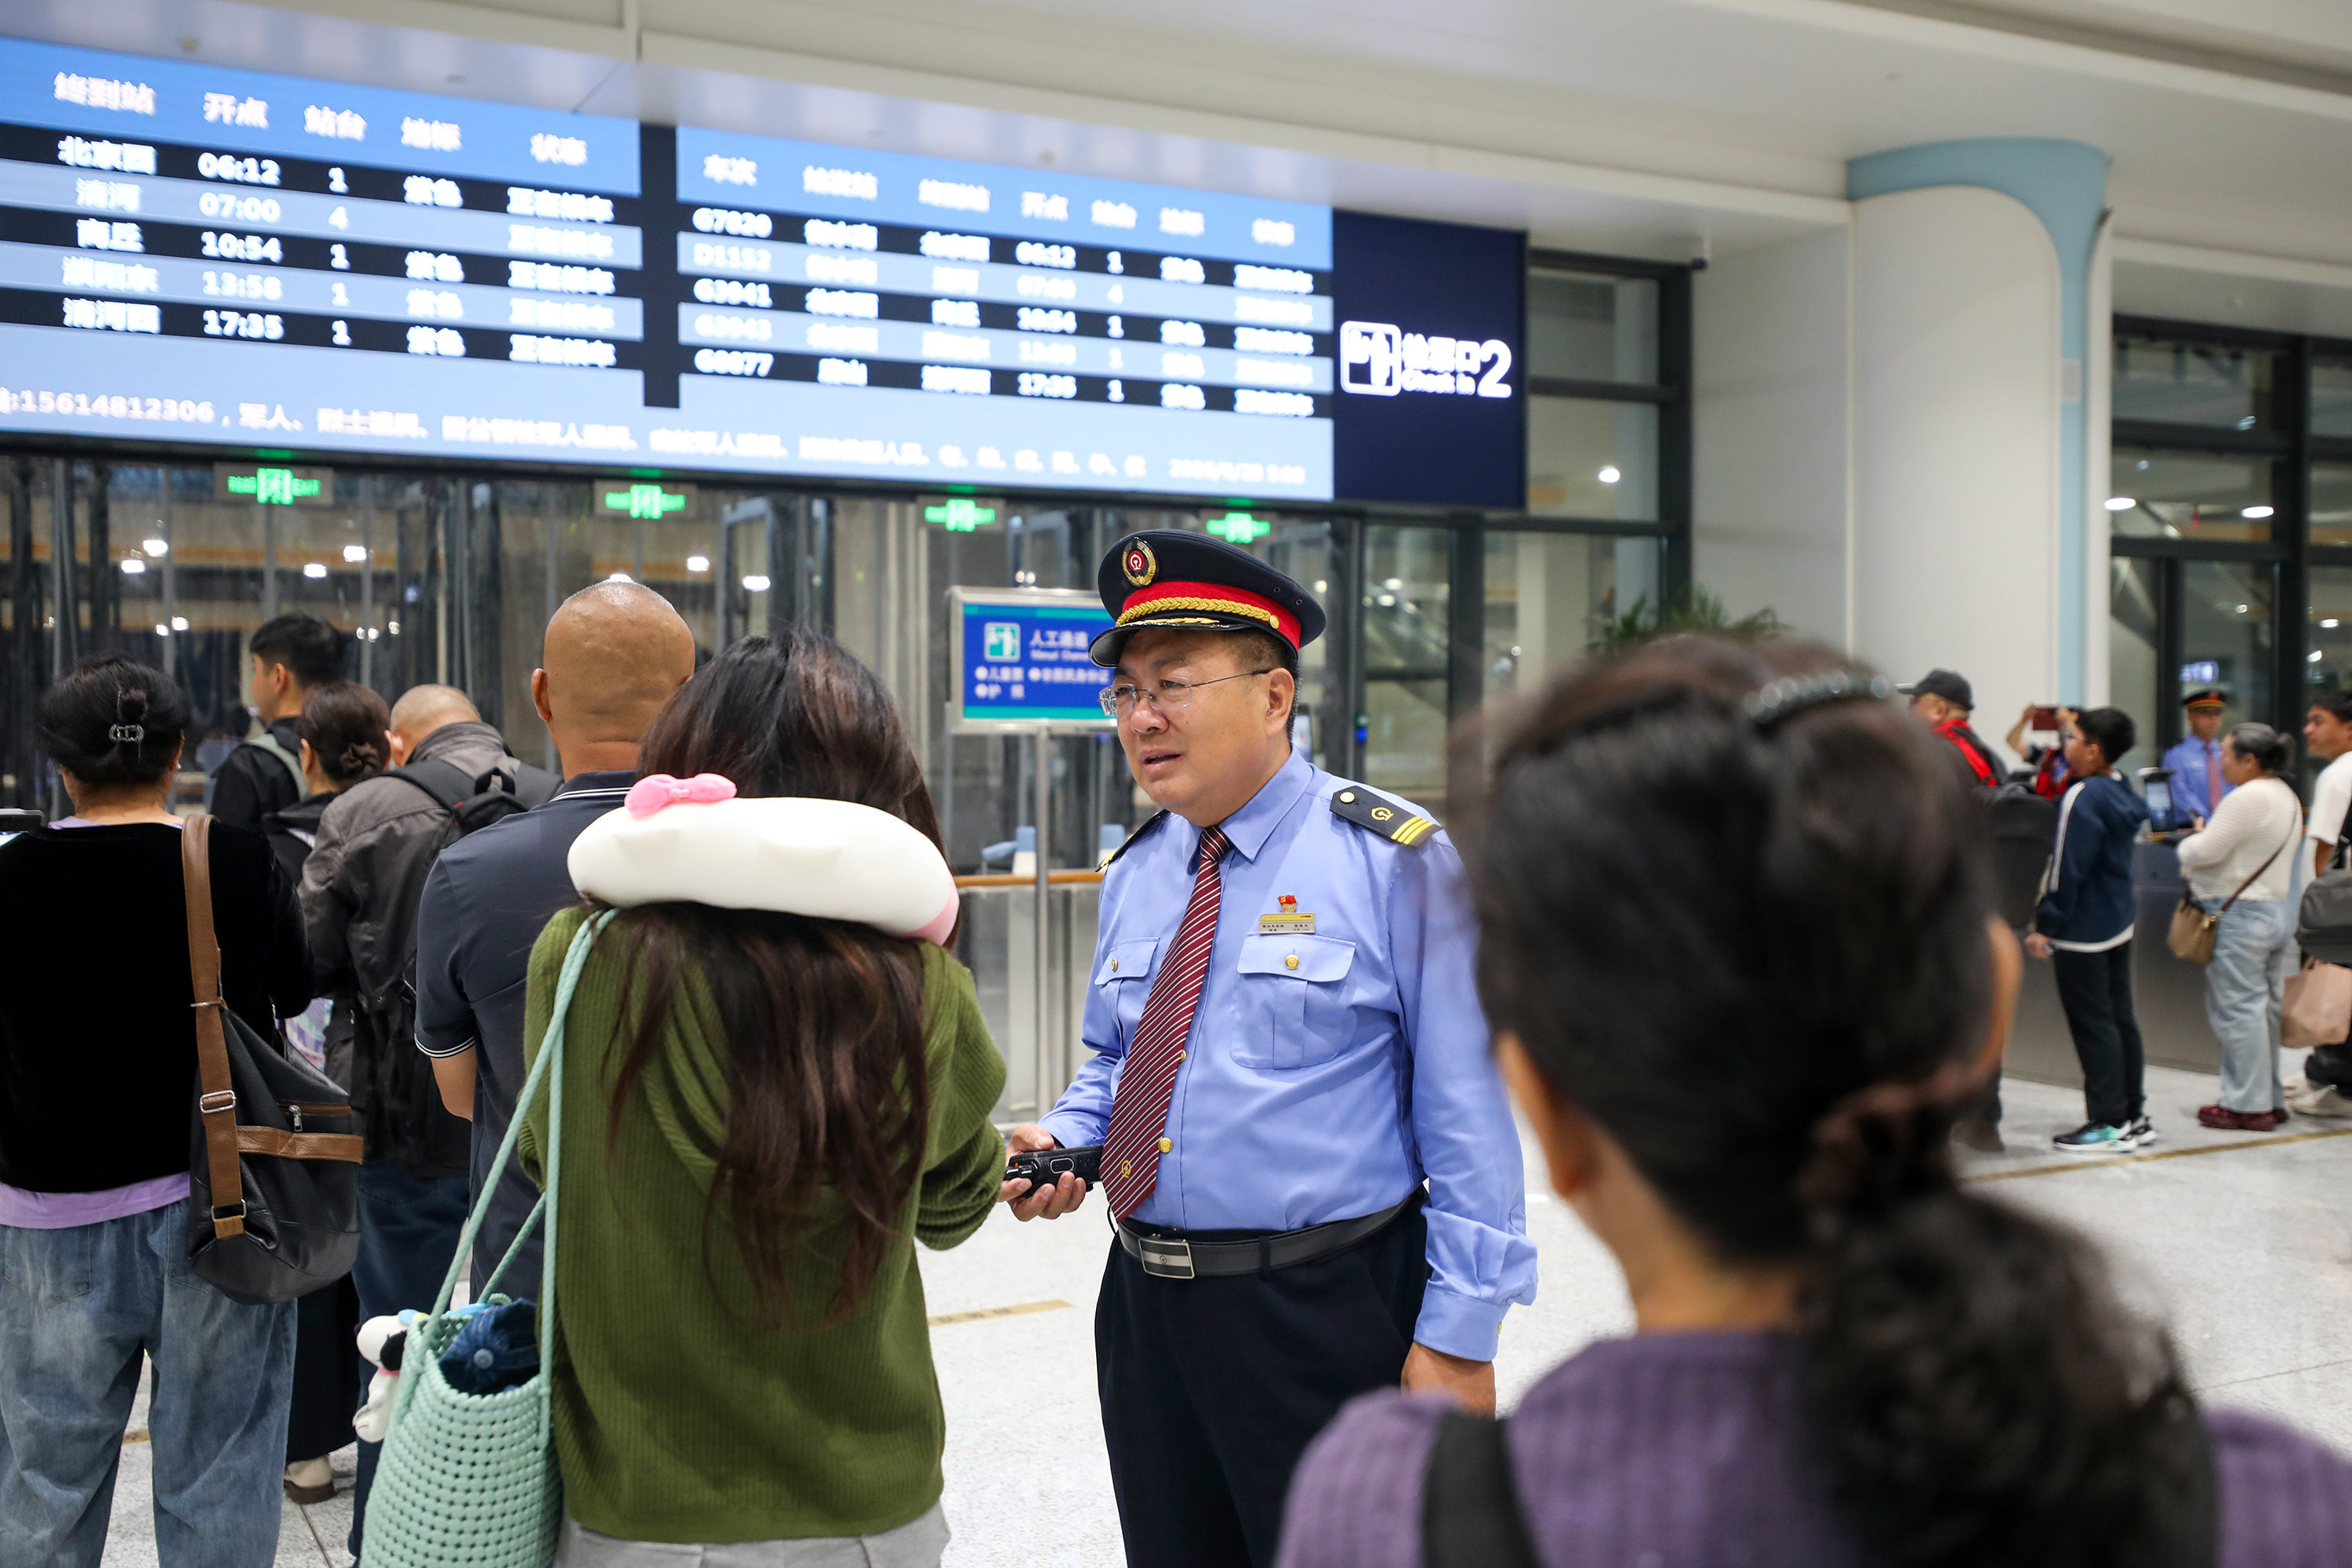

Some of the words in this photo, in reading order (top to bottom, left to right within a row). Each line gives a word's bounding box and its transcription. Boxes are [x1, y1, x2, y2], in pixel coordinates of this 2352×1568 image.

[204, 93, 269, 129] 开点
[60, 136, 155, 175] 北京西
[198, 153, 280, 185] 06:12
[331, 168, 348, 193] 1
[199, 192, 282, 224] 07:00
[328, 205, 350, 231] 4
[203, 231, 282, 262] 10:54
[332, 244, 350, 269] 1
[1108, 250, 1125, 274] 1
[332, 282, 350, 308] 1
[205, 310, 284, 339] 17:35
[334, 321, 351, 346] 1
[1108, 314, 1125, 339] 1
[1477, 339, 1512, 399] 2
[1108, 379, 1126, 404] 1
